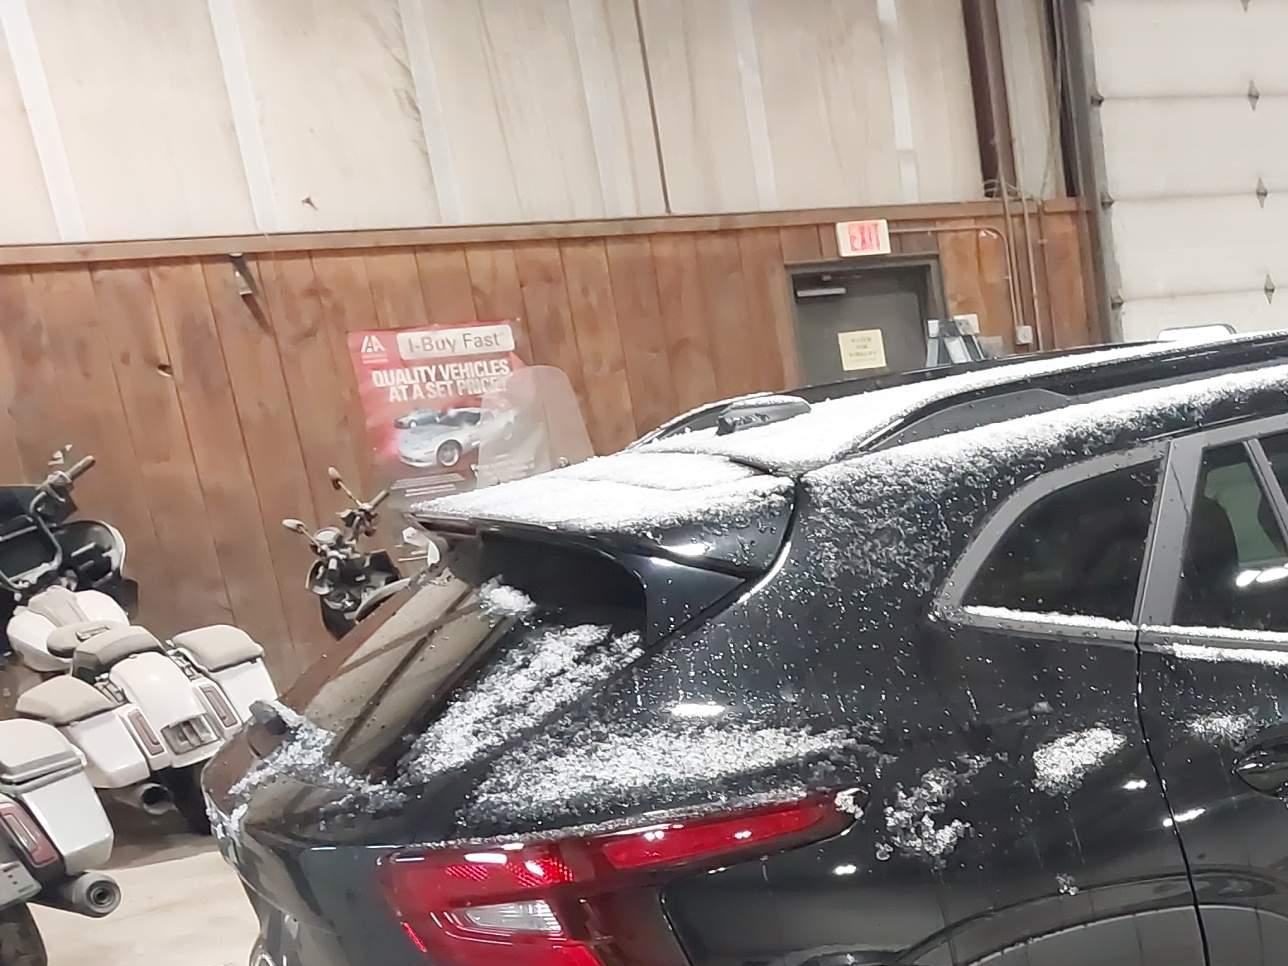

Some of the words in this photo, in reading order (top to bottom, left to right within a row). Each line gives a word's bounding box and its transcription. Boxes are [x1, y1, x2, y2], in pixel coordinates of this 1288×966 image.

[849, 221, 881, 252] EXIT
[408, 336, 457, 354] I-Buy
[461, 332, 501, 349] Fast
[372, 365, 436, 388] QUALITY
[438, 358, 510, 382] VEHICLES
[388, 385, 408, 403] AT
[412, 383, 425, 401] A
[425, 380, 455, 399] SET
